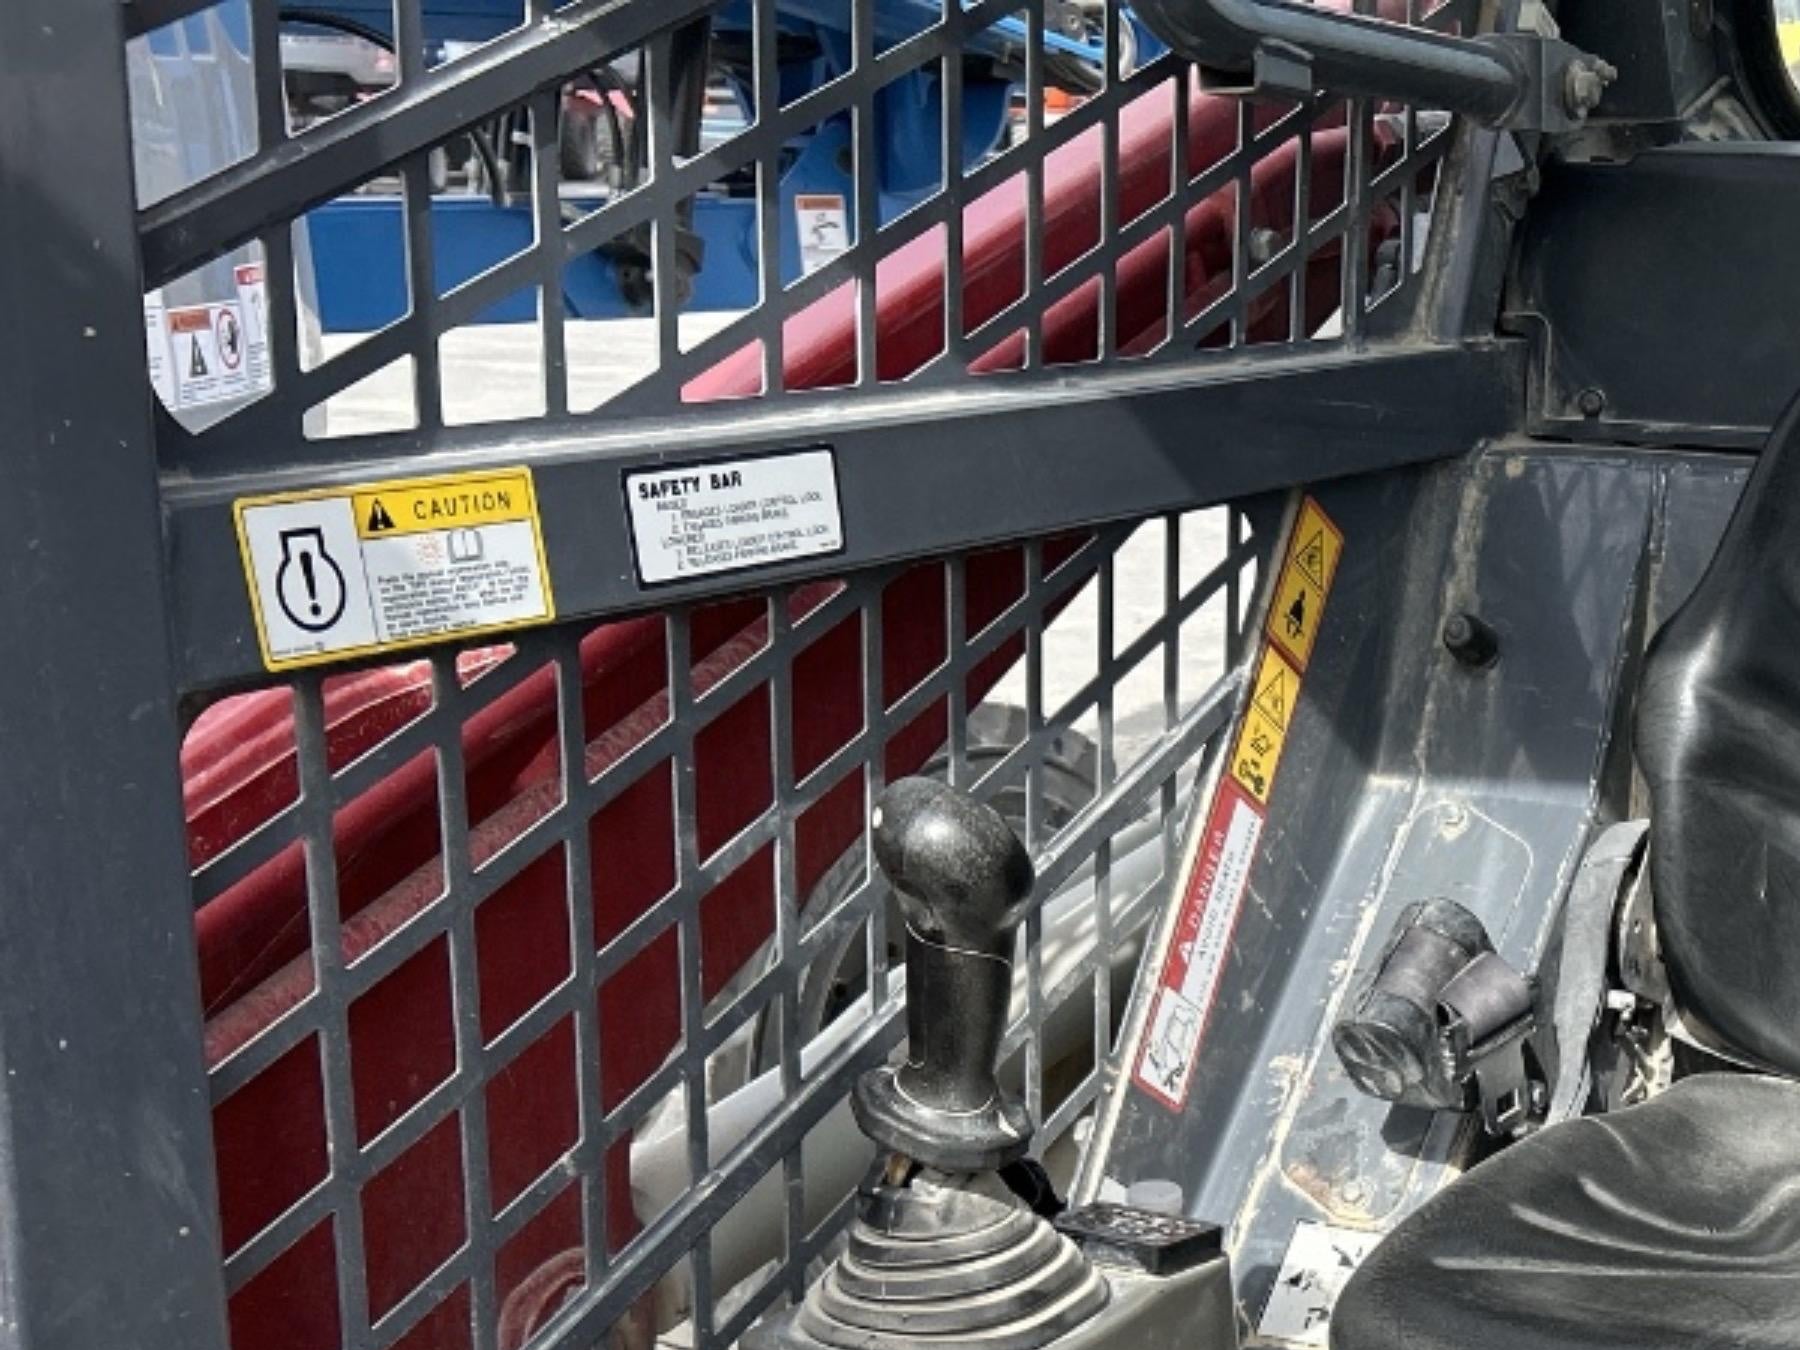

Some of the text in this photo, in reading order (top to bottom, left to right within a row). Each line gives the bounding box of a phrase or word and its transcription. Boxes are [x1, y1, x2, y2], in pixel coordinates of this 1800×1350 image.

[638, 470, 743, 500] SAFETY BAR
[412, 490, 512, 521] CAUTION
